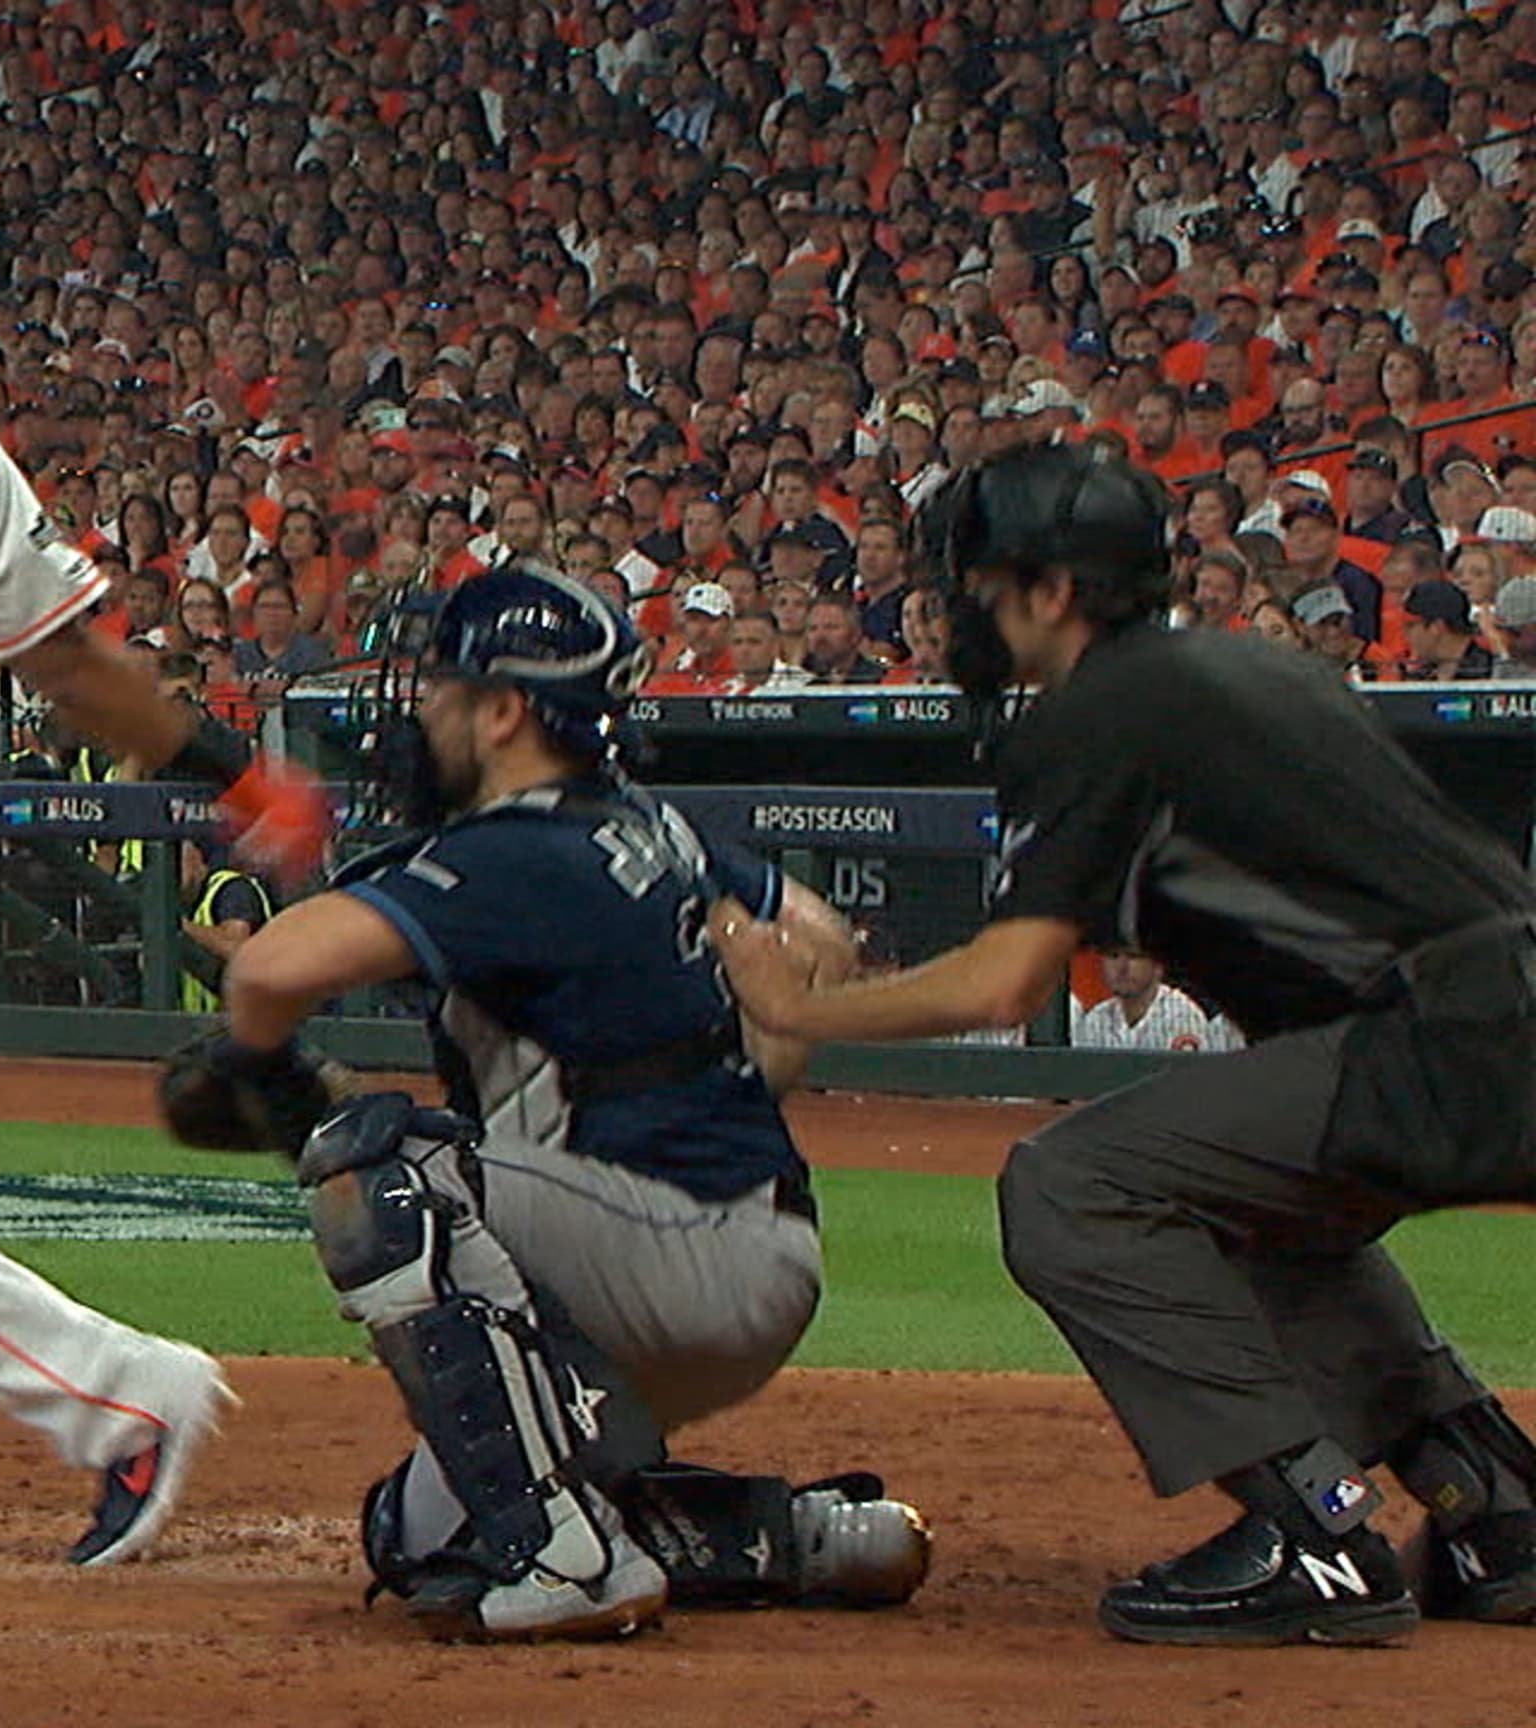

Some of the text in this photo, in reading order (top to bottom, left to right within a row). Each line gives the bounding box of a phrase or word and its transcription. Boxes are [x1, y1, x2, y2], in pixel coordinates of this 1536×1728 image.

[755, 806, 895, 833] #POSTSEASON
[1299, 1551, 1371, 1599] N
[1448, 1541, 1488, 1584] N
